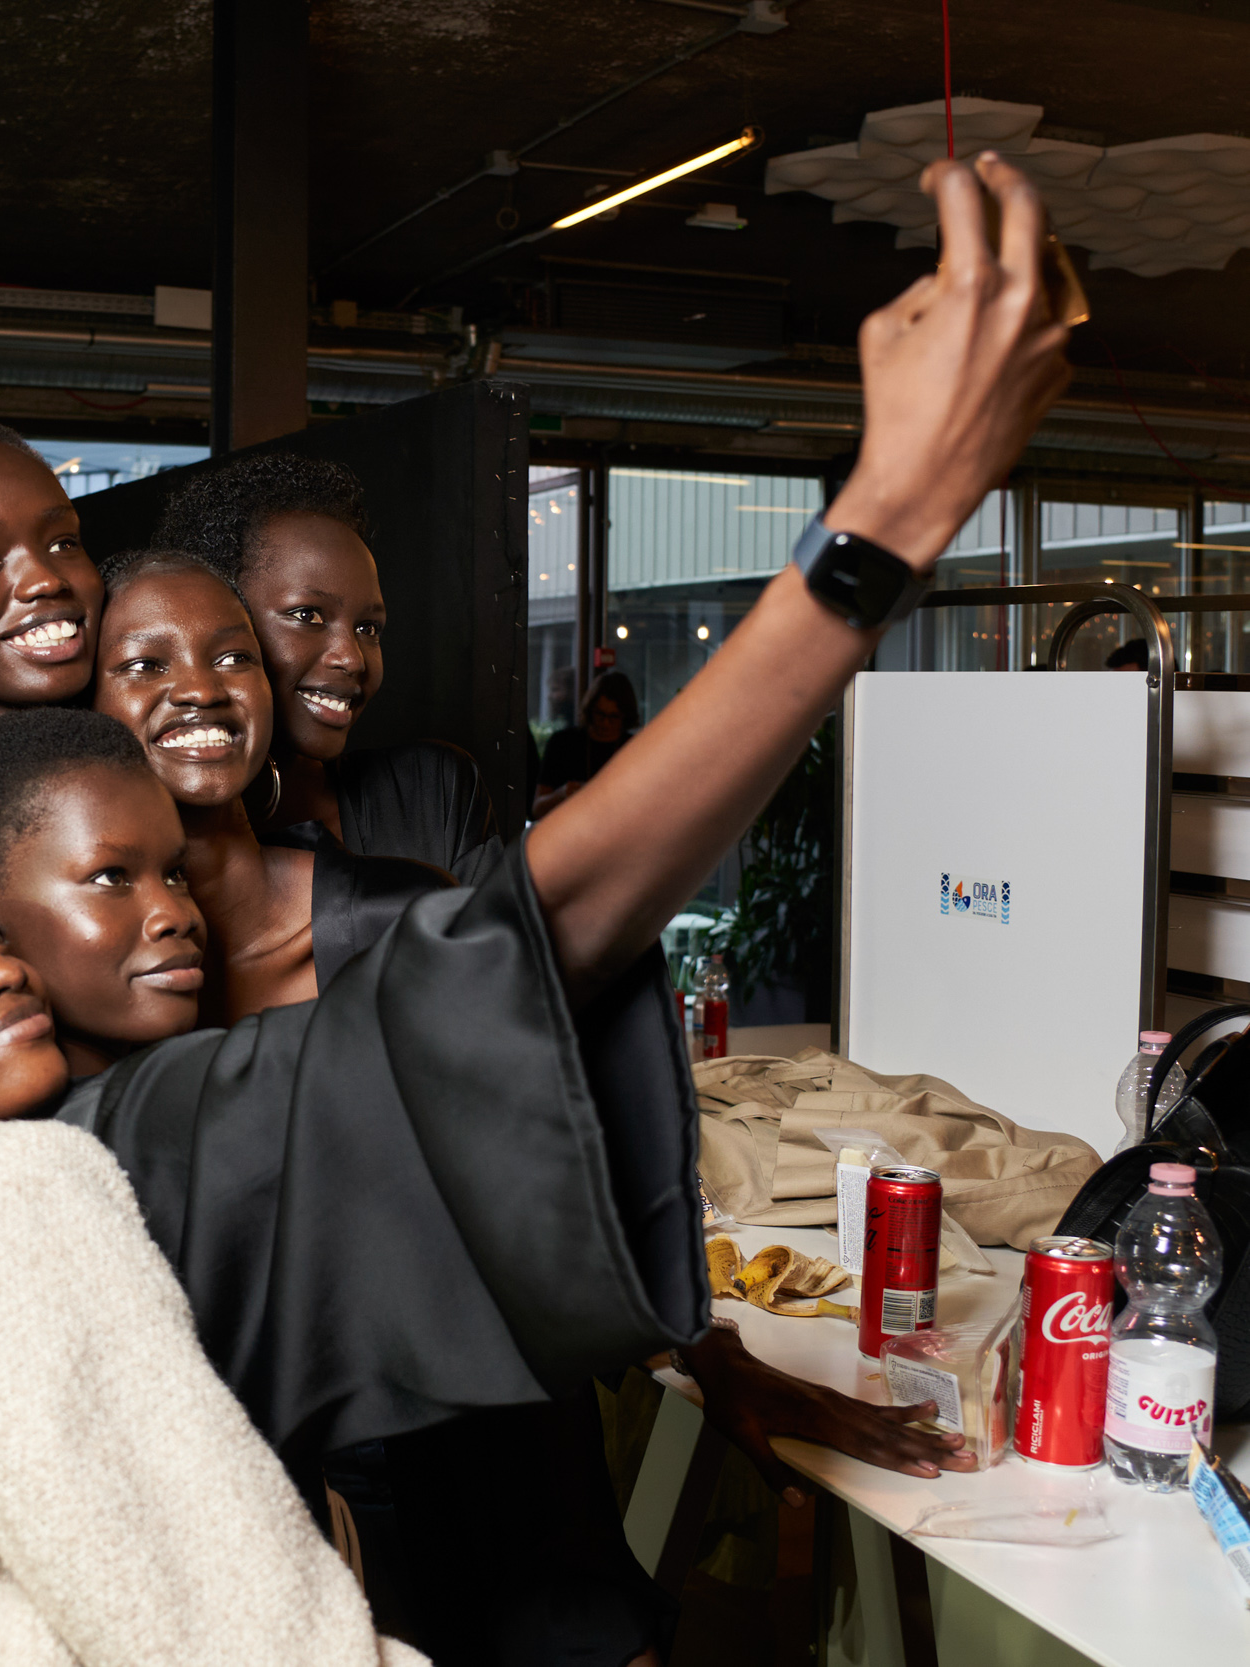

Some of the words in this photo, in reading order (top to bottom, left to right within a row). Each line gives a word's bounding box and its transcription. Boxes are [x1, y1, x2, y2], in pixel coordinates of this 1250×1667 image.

[972, 881, 997, 902] ORA
[972, 899, 998, 914] PESCE
[1137, 1395, 1208, 1427] GUIZZA
[1030, 1399, 1042, 1454] RICICLAMI
[1147, 1439, 1192, 1449] NATURAL
